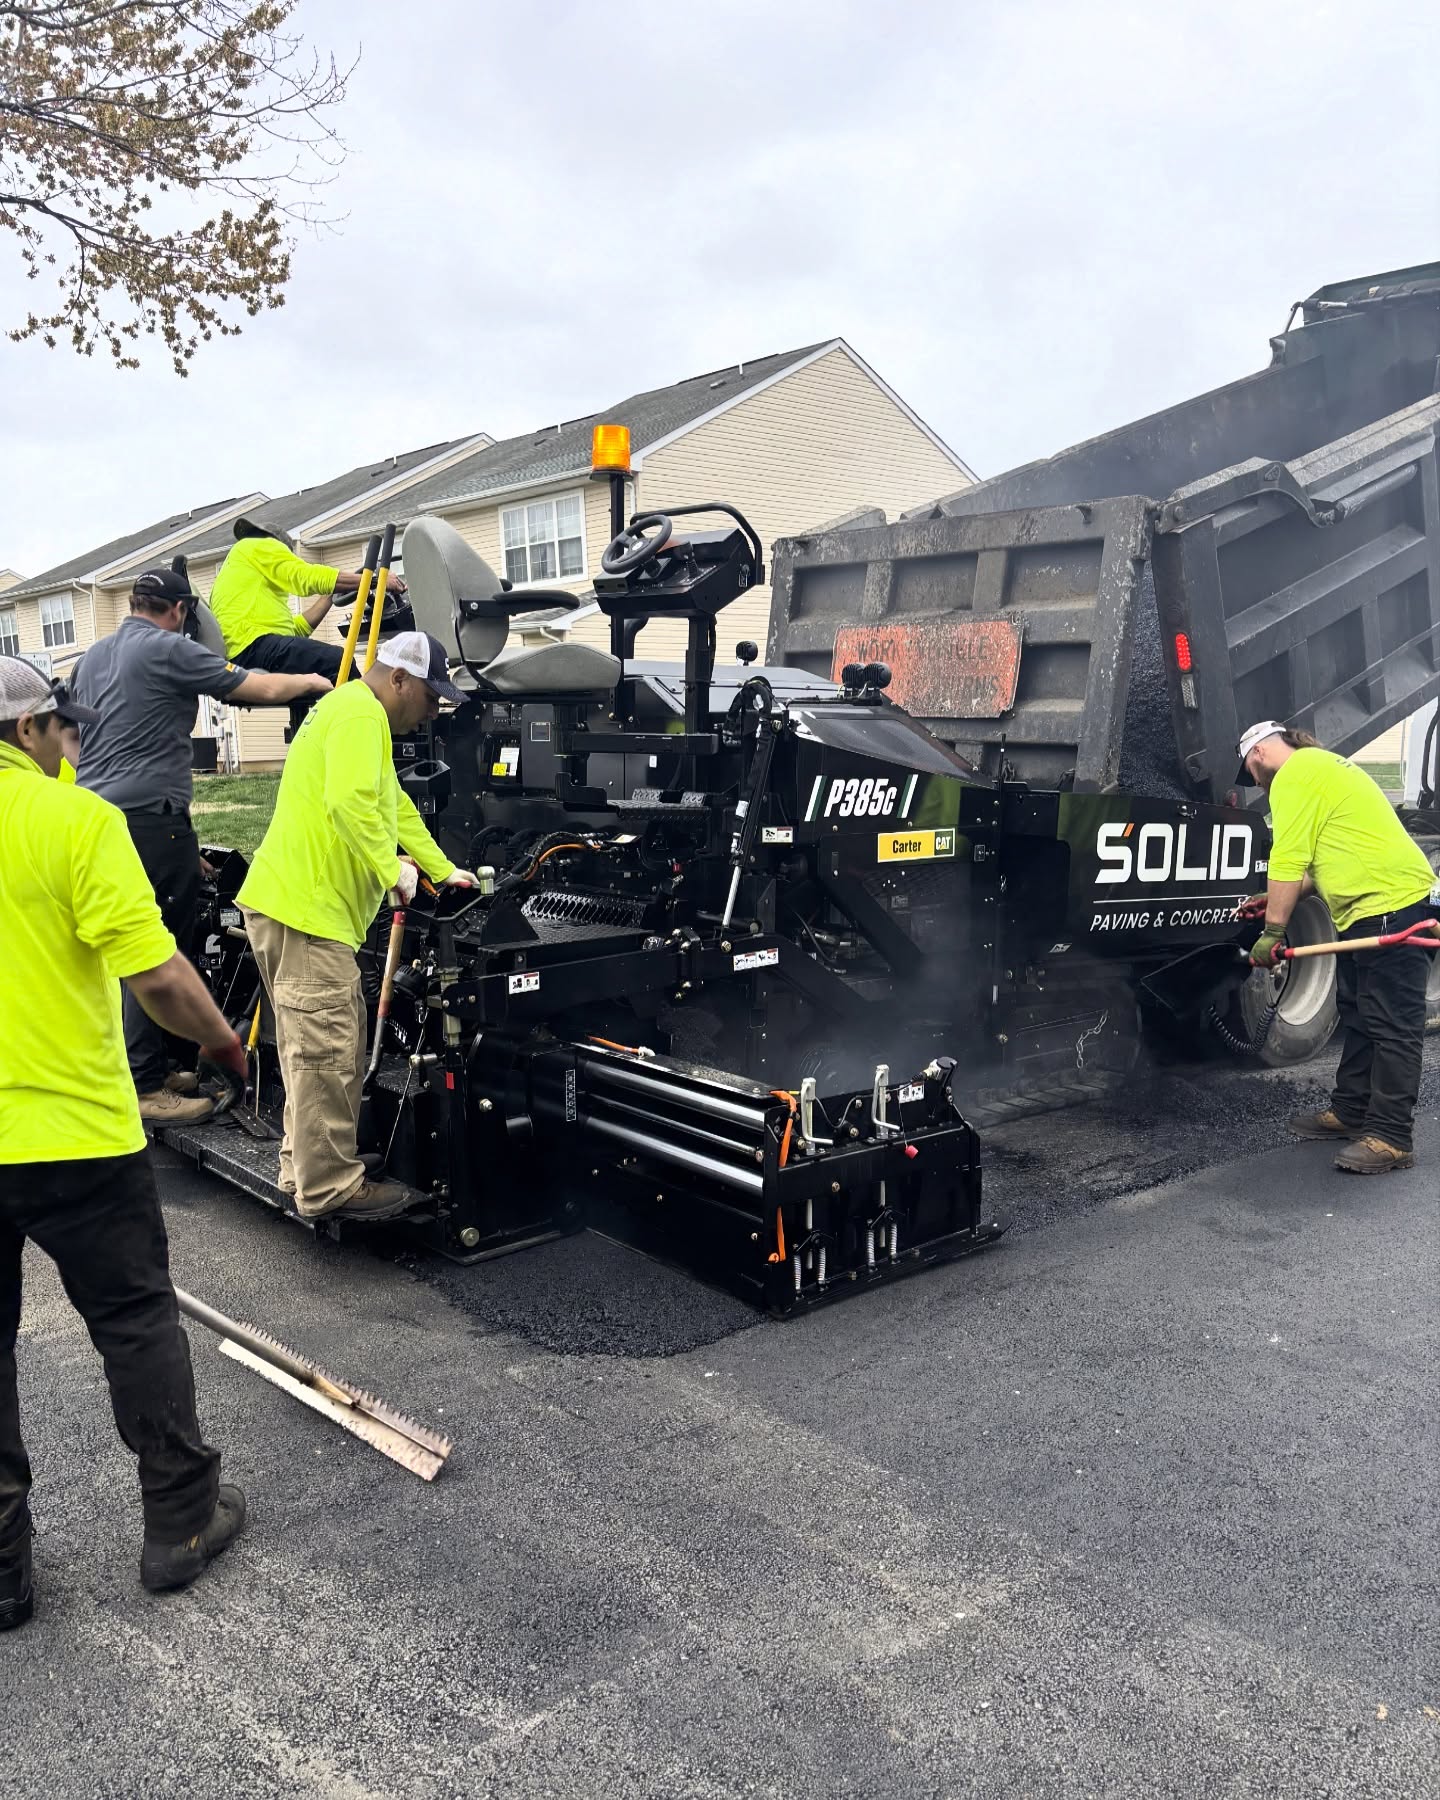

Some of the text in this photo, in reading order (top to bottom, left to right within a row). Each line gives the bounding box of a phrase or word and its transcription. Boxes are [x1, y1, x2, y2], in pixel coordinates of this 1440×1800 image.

[892, 838, 922, 854] Carter
[935, 836, 951, 850] CAT
[1094, 822, 1253, 884] SOLID
[1089, 912, 1150, 932] PAVING
[1153, 911, 1165, 927] &
